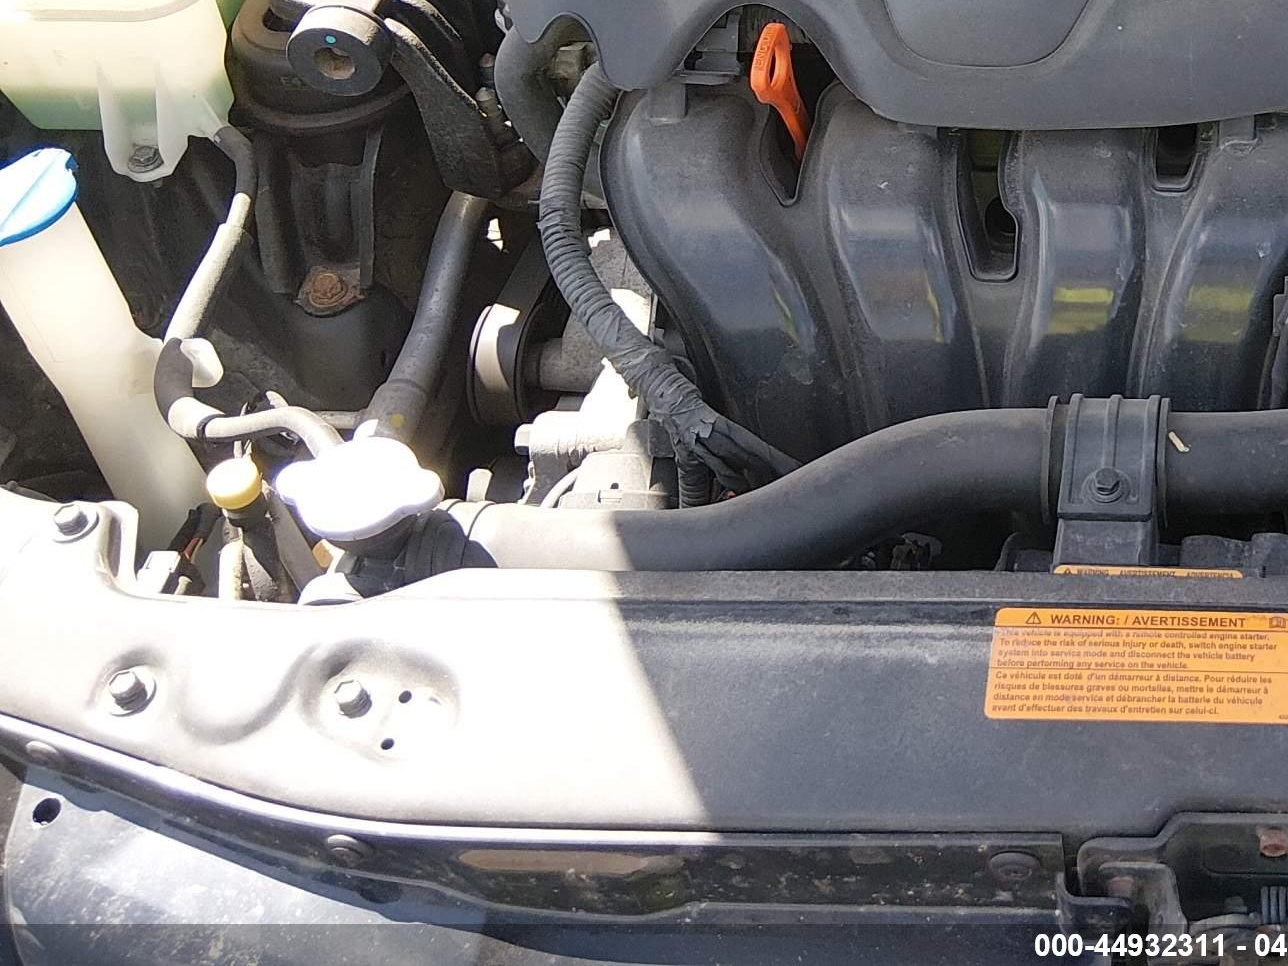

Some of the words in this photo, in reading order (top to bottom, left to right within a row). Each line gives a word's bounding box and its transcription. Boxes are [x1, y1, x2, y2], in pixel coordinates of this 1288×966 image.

[1050, 613, 1119, 625] WARNING:
[1124, 615, 1128, 625] /
[1132, 615, 1246, 628] AVERTISSEMENT
[1064, 629, 1103, 639] equipped
[1106, 630, 1123, 638] with
[1209, 633, 1238, 642] engine
[1012, 638, 1041, 646] reduce
[1122, 641, 1146, 650] injury
[1160, 641, 1186, 650] death,
[1189, 642, 1216, 650] switch
[1218, 643, 1247, 652] engine
[1250, 643, 1276, 651] starter
[998, 648, 1029, 658] system
[1050, 649, 1082, 657] service
[1109, 650, 1126, 658] and
[1127, 651, 1175, 659] disconnect
[1192, 652, 1223, 660] vehicle
[1225, 653, 1256, 663] battery
[1027, 659, 1074, 669] performing
[996, 670, 1007, 678] Ce
[1010, 670, 1046, 679] véhicule
[1048, 671, 1061, 679] est
[1064, 671, 1083, 680] doté
[1108, 672, 1154, 681] démarreur
[1156, 673, 1160, 682] à
[1163, 673, 1201, 682] distance.
[1204, 674, 1224, 683] Pour
[1226, 675, 1258, 684] réduire
[1260, 676, 1272, 684] les
[994, 681, 1026, 691] risques
[1042, 682, 1084, 690] blessures
[1086, 685, 1115, 693] graves
[1132, 684, 1174, 693] mortelles,
[1176, 685, 1204, 693] mettre
[1216, 686, 1261, 694] démarreur
[994, 692, 1030, 700] distance
[1046, 693, 1070, 701] mode
[1073, 693, 1103, 702] service
[1106, 694, 1114, 702] et
[1116, 694, 1165, 703] débrancher
[1178, 696, 1210, 704] batterie
[1227, 697, 1262, 705] véhicule
[992, 702, 1016, 710] avant
[1018, 703, 1065, 711] d'effectuer
[1067, 704, 1083, 712] des
[1085, 704, 1118, 712] travaux
[1120, 705, 1166, 713] d'entretien
[1185, 707, 1219, 715] celui-ci.
